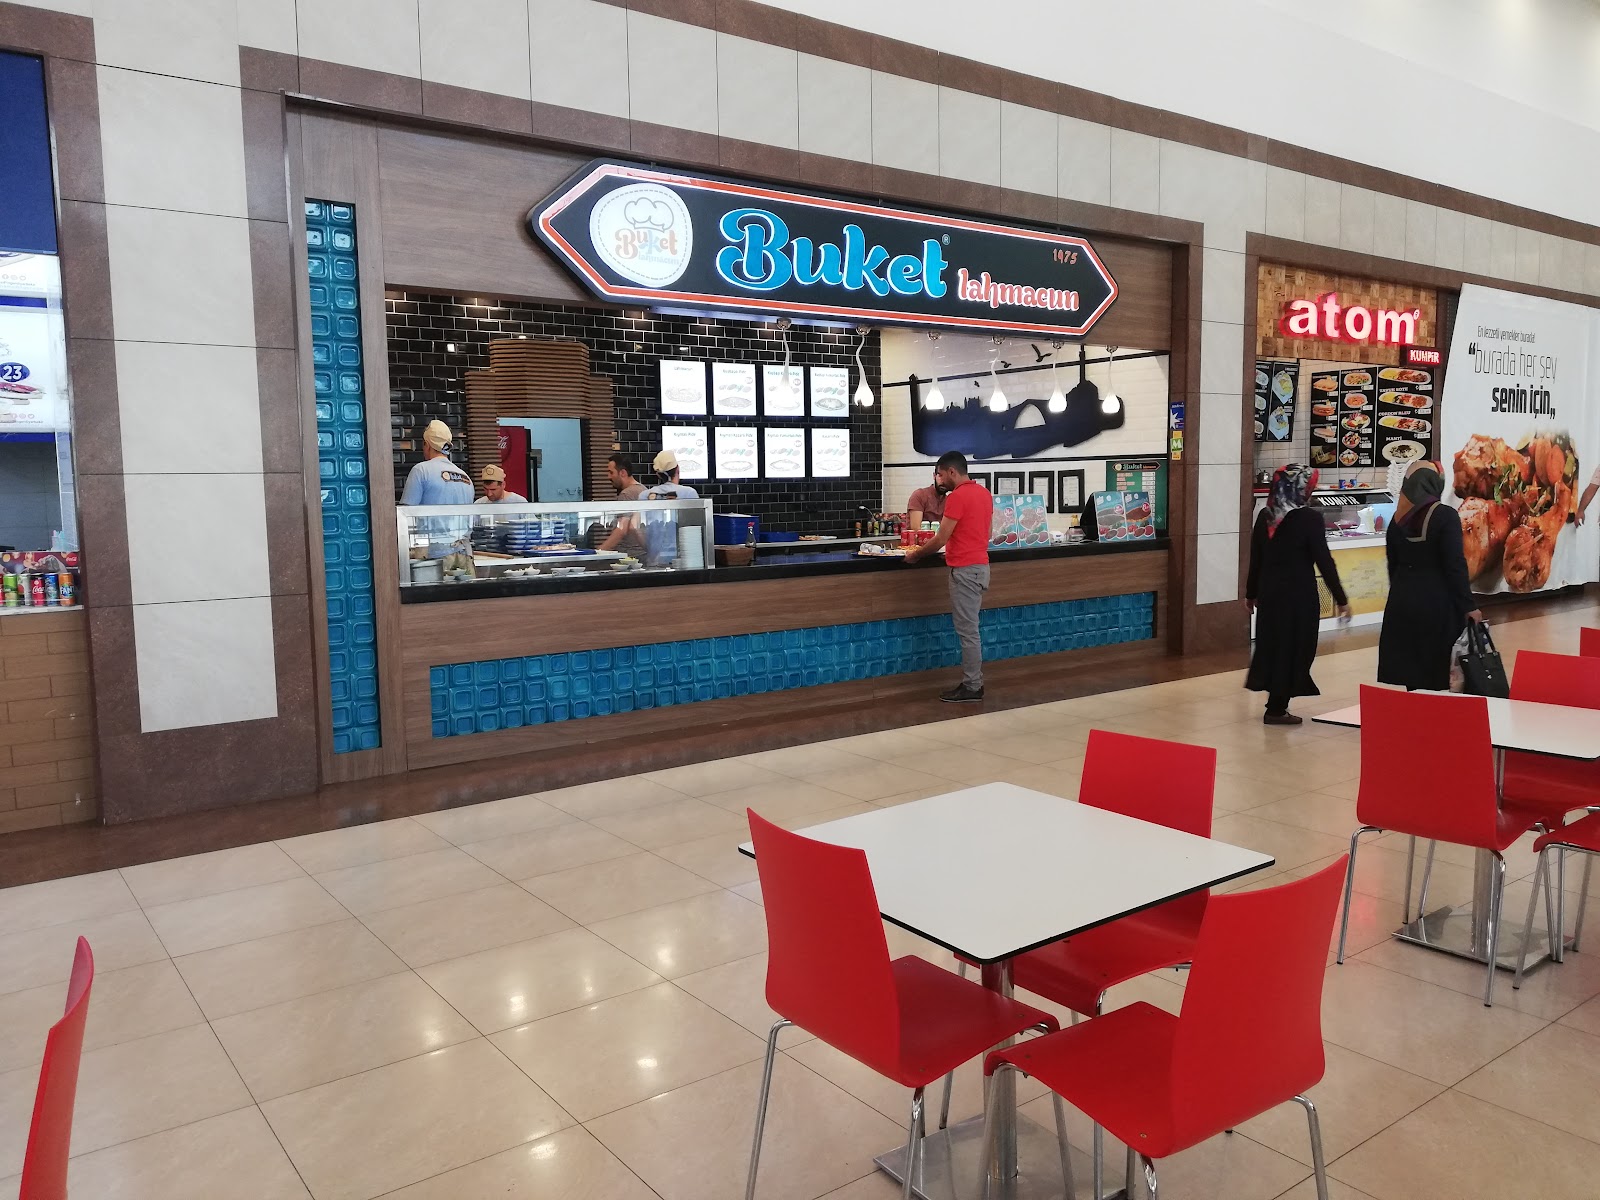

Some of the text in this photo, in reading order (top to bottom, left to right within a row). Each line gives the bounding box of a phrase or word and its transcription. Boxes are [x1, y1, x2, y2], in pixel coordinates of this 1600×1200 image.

[614, 228, 678, 260] Buket
[715, 207, 948, 298] Buket
[1053, 248, 1079, 265] 1975
[957, 267, 1080, 312] lahmacun
[1287, 291, 1415, 345] atom
[2, 365, 23, 380] 23
[1519, 346, 1537, 378] her
[1491, 383, 1527, 414] senin
